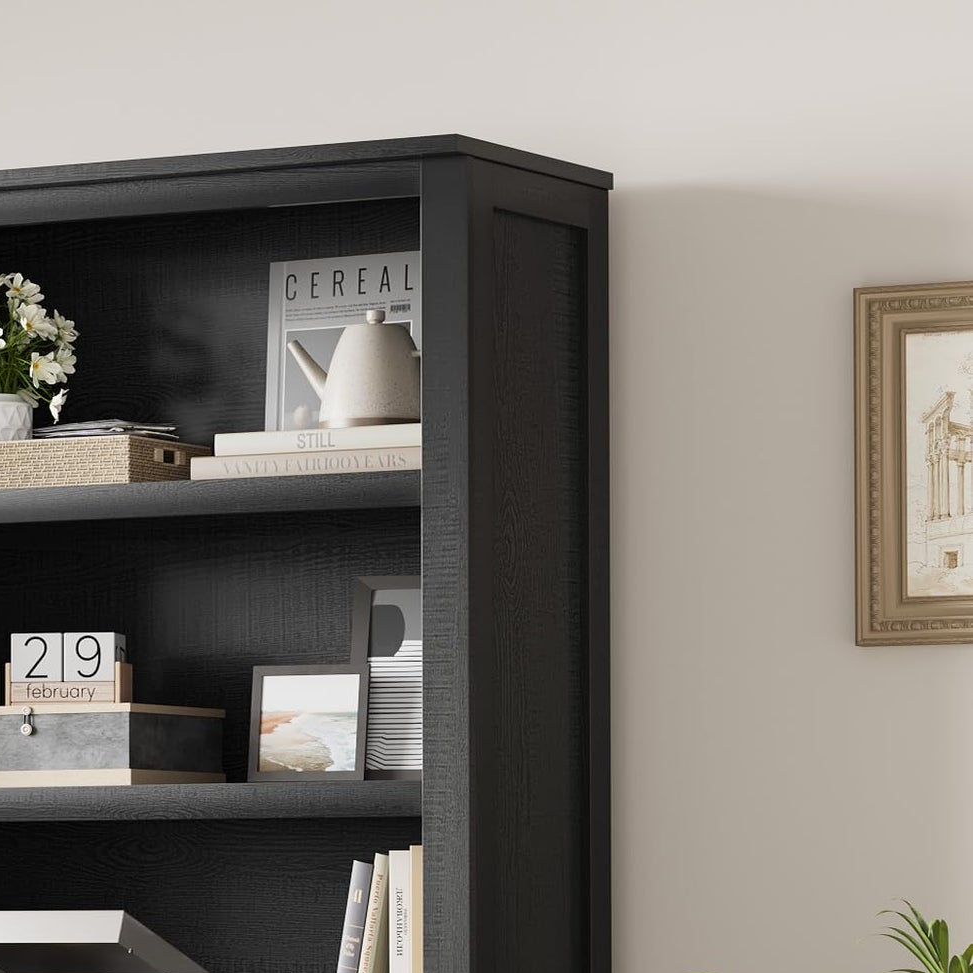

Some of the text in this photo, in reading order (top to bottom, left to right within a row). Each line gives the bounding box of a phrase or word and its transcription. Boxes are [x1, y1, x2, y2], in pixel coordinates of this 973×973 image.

[285, 263, 414, 301] CEREAL
[296, 432, 336, 449] STILL
[26, 683, 96, 701] february
